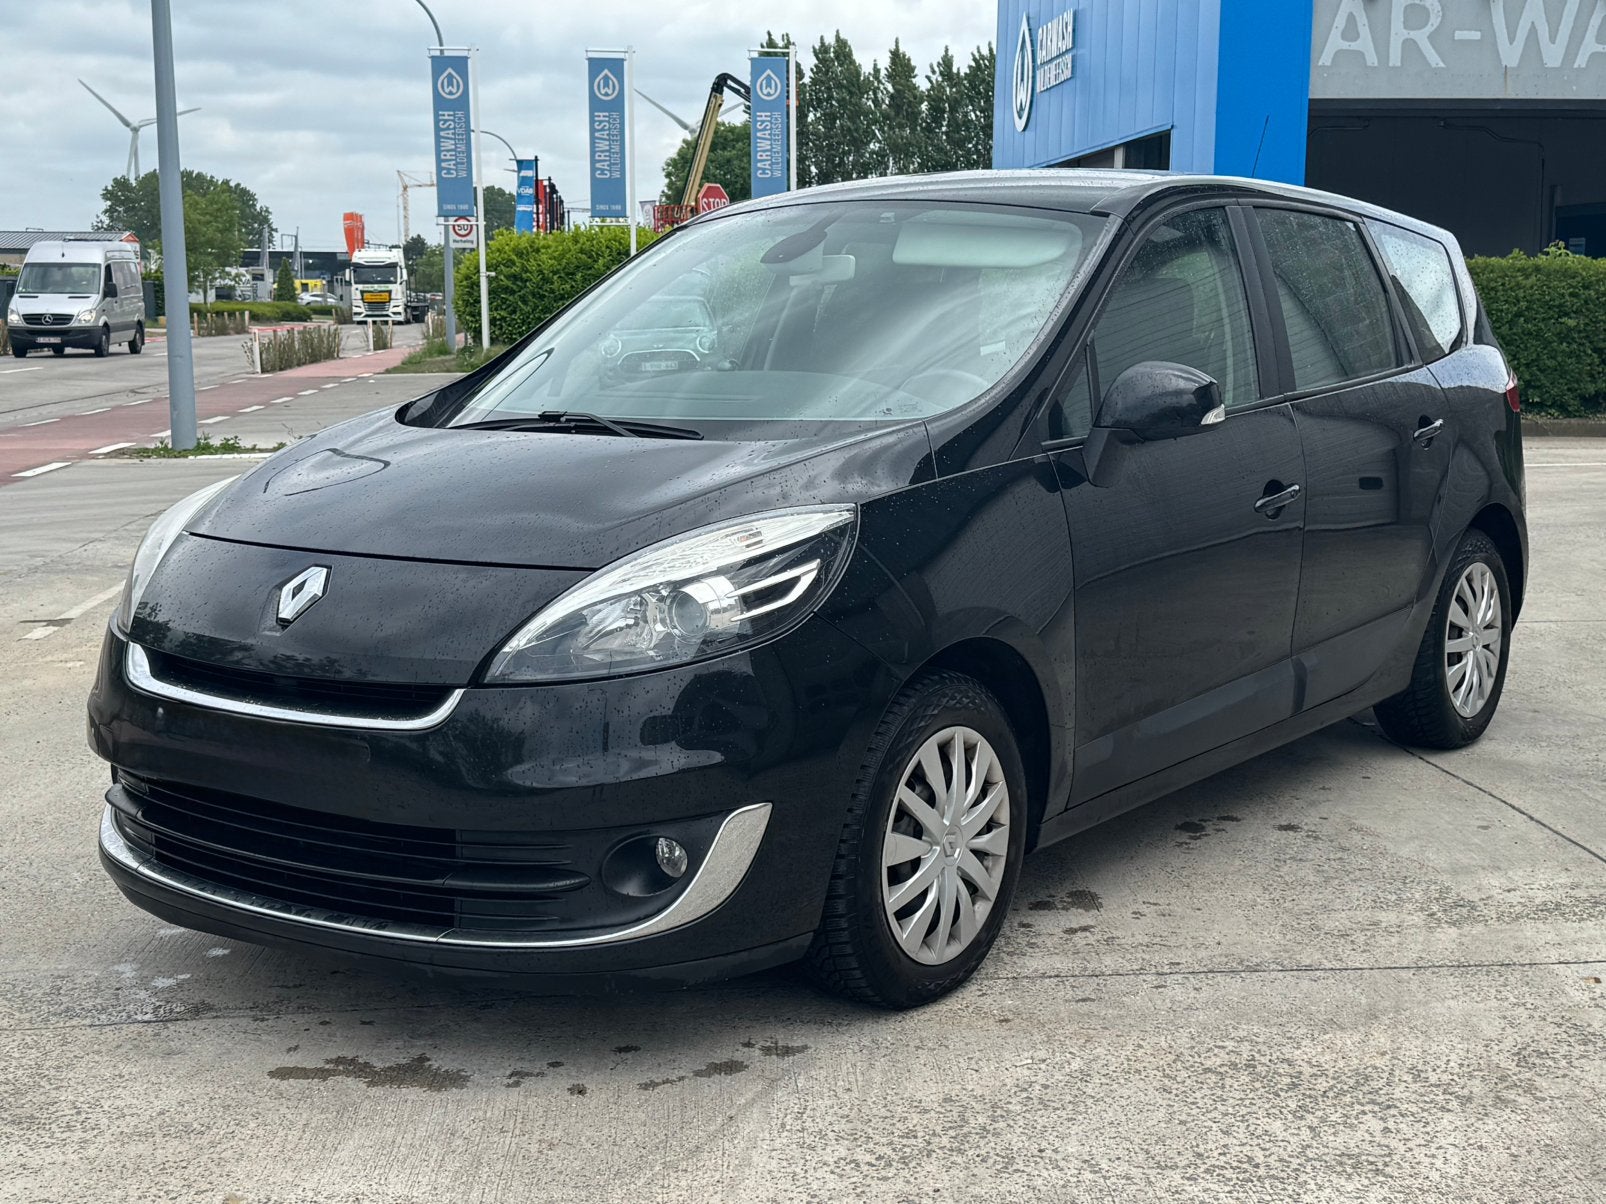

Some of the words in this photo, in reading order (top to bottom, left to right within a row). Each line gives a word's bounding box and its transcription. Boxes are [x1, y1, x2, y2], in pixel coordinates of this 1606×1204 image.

[1037, 8, 1073, 65] CARWASH
[439, 111, 456, 178] CARWASH
[455, 111, 467, 178] WILDEMEERSCH
[594, 112, 610, 179] CARWASH
[609, 112, 621, 179] WILDEMEERSCH
[756, 112, 771, 178] CARWASH
[771, 112, 782, 178] WILDEMEERSCH
